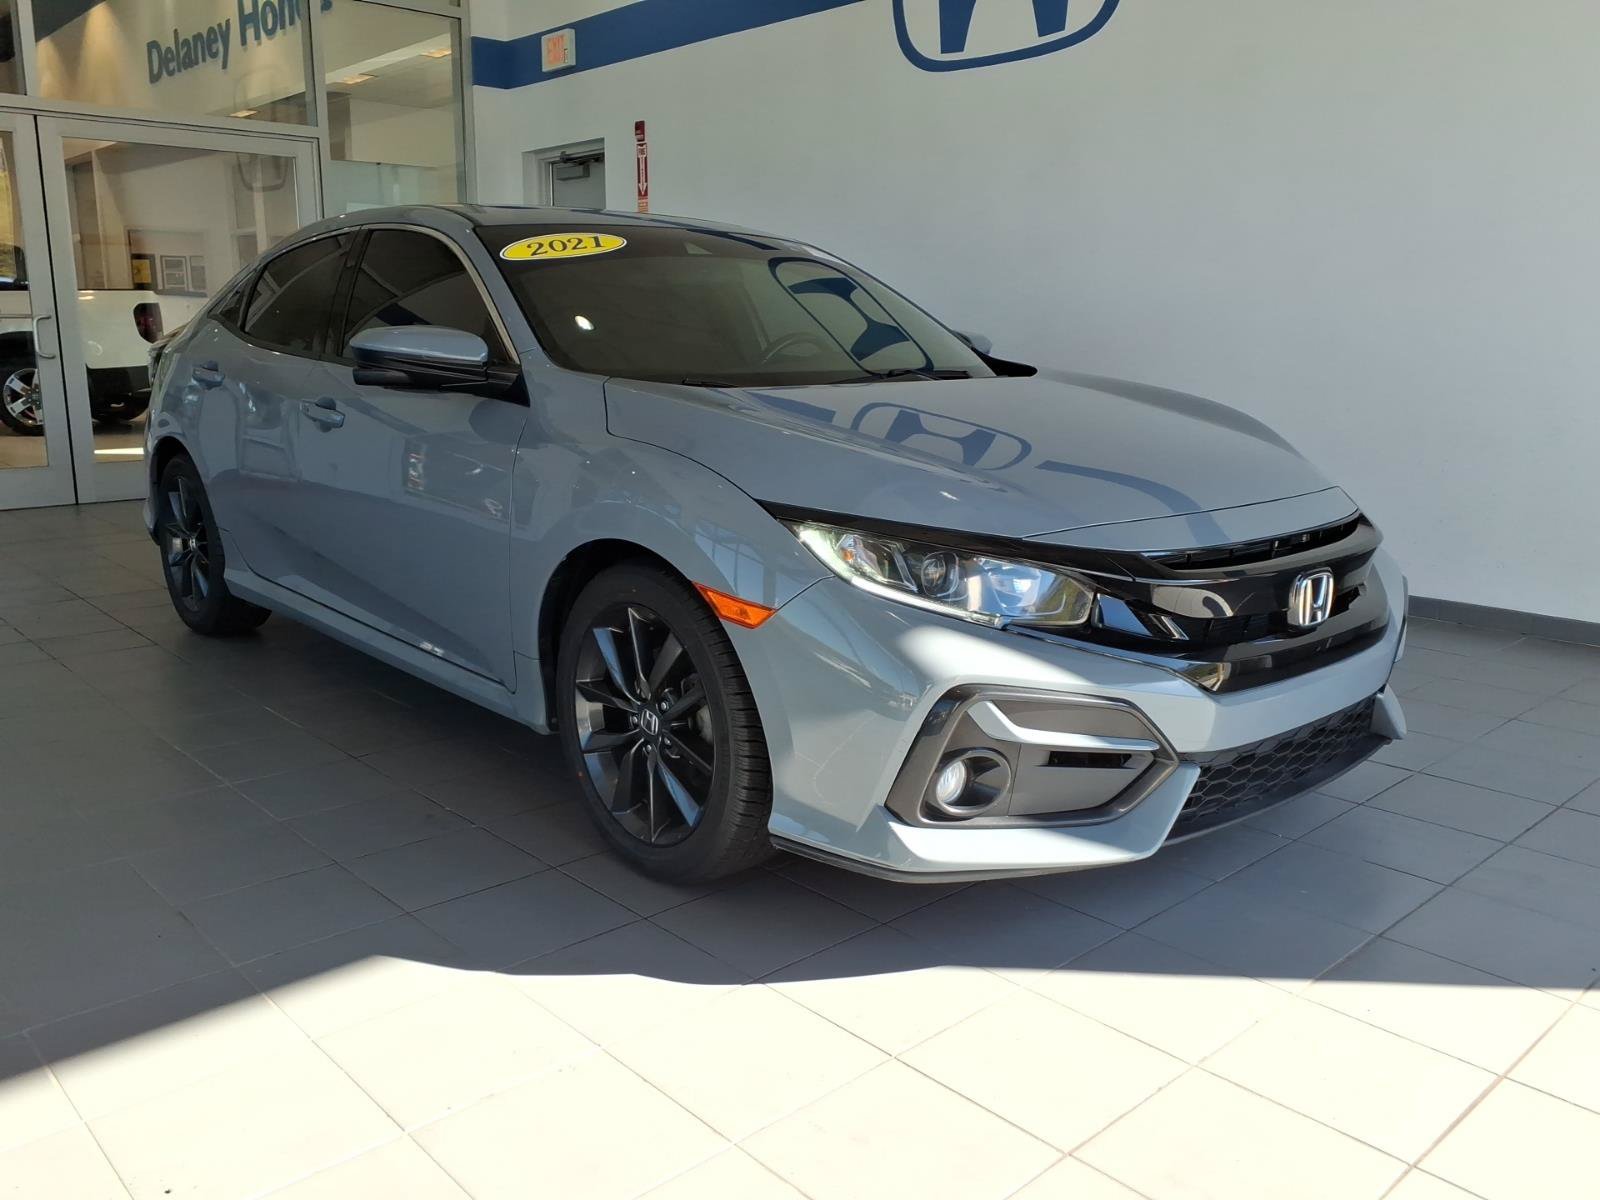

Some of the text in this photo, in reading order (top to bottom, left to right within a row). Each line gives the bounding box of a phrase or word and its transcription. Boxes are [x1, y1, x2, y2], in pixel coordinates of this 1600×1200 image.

[146, 0, 333, 84] Delaney Hon
[526, 235, 606, 257] 2021
